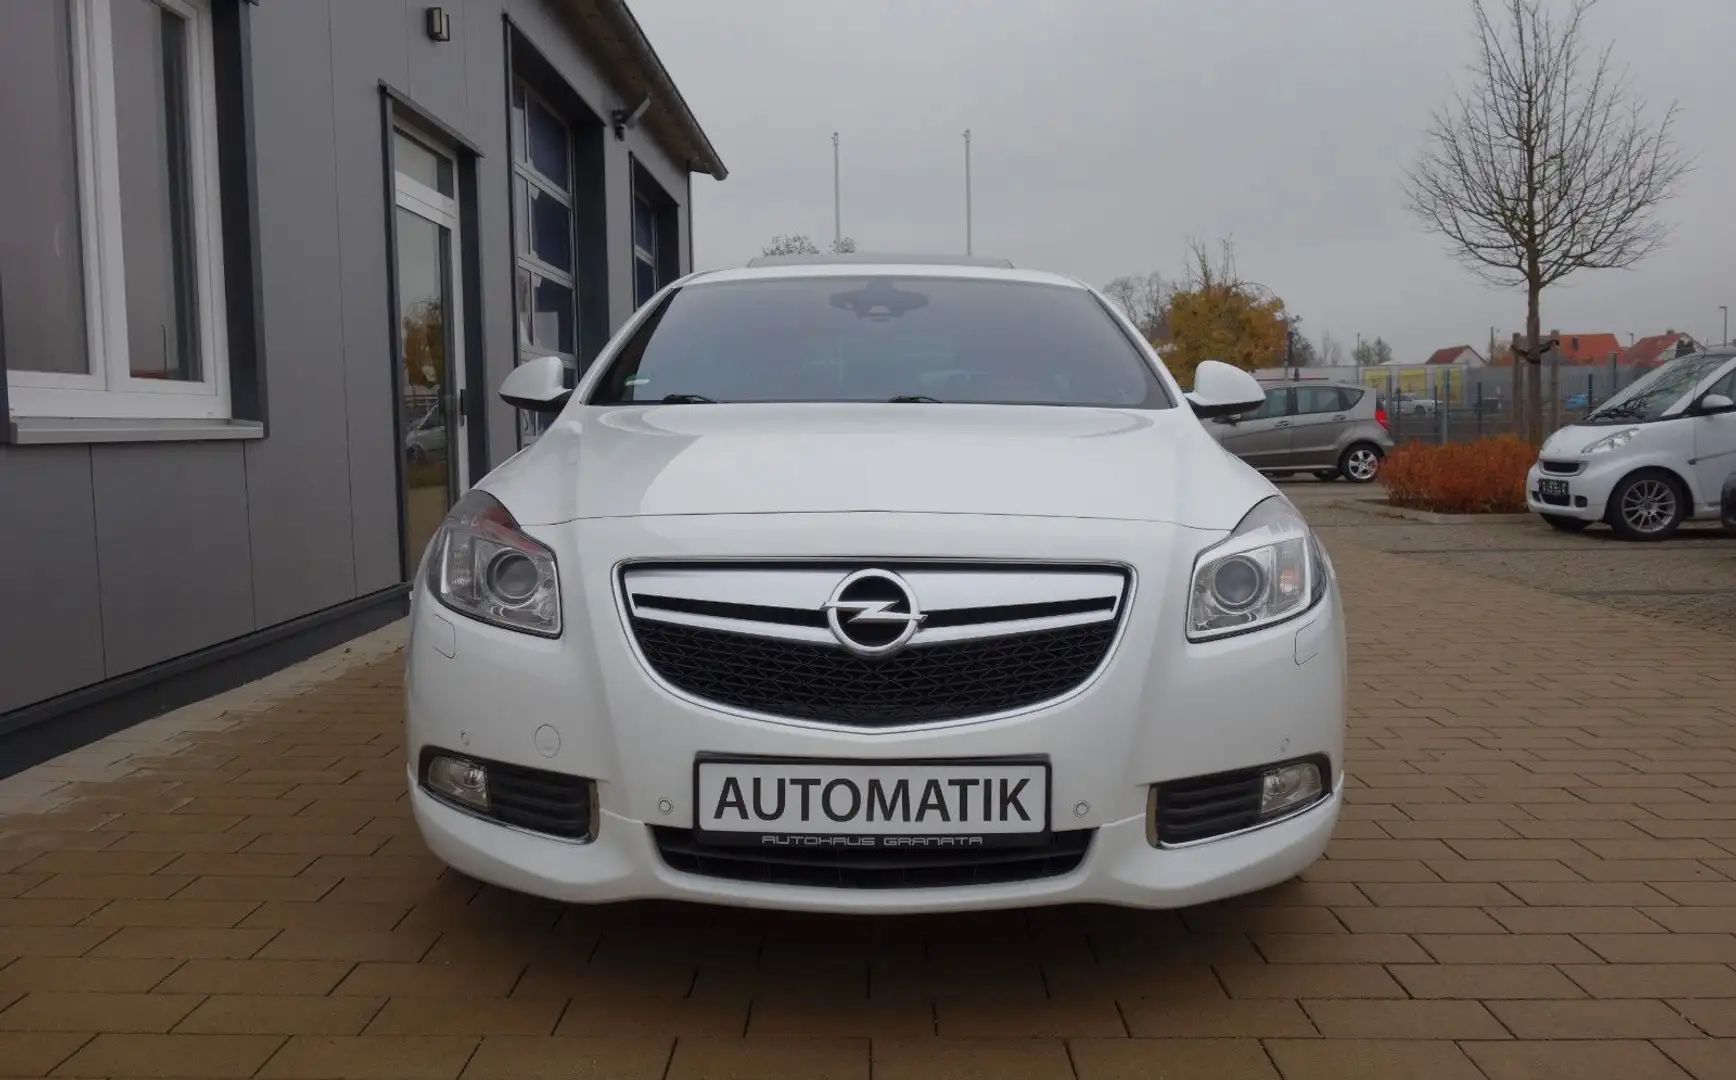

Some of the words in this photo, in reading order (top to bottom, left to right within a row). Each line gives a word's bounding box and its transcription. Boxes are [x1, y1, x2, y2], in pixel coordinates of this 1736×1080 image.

[713, 777, 1032, 823] AUTOMATIK
[761, 835, 875, 846] AUTOHAUS
[883, 836, 983, 846] GRANATA
